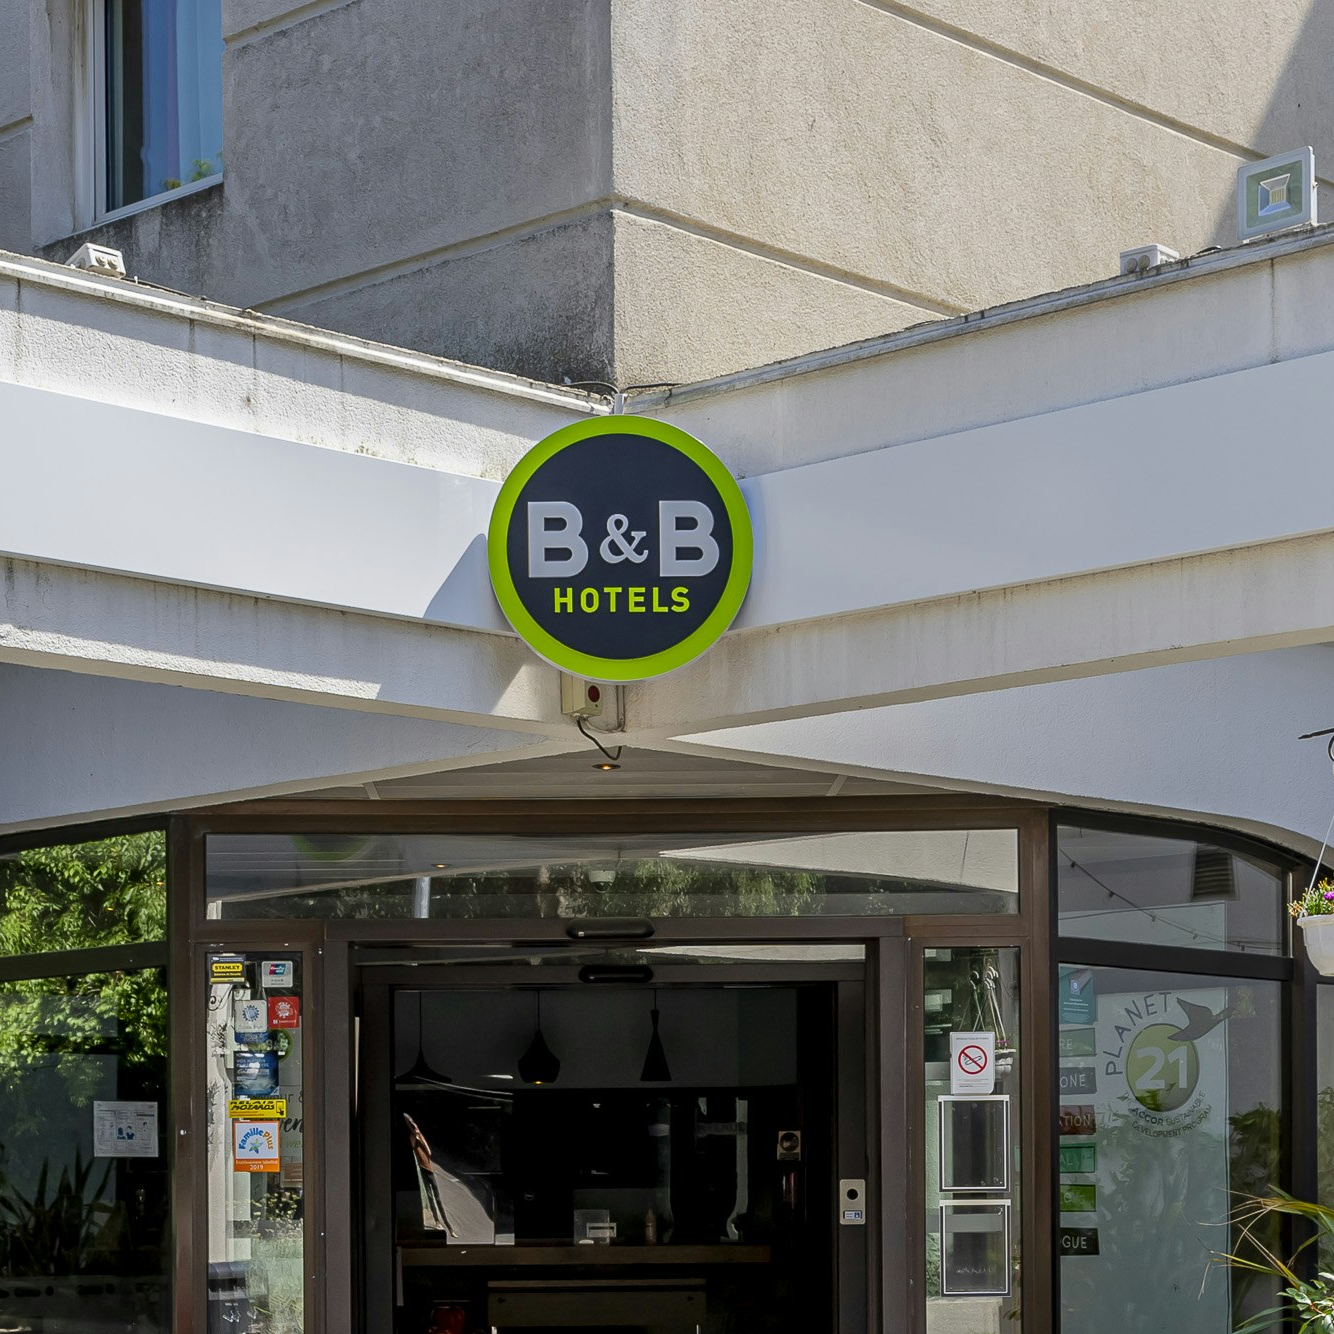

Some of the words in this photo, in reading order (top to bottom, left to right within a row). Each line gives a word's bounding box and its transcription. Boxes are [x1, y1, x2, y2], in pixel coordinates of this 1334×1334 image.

[527, 500, 720, 578] B&B
[553, 586, 691, 614] HOTELS
[1103, 992, 1172, 1076] PLANET
[1135, 1045, 1188, 1090] 21
[1131, 1107, 1164, 1126] ACCOR
[1166, 1091, 1207, 1126] SUSTAINABLE
[1132, 1121, 1182, 1138] DEVELOPMENT
[1181, 1104, 1213, 1132] PROGRAM
[1060, 1235, 1088, 1249] GUE
